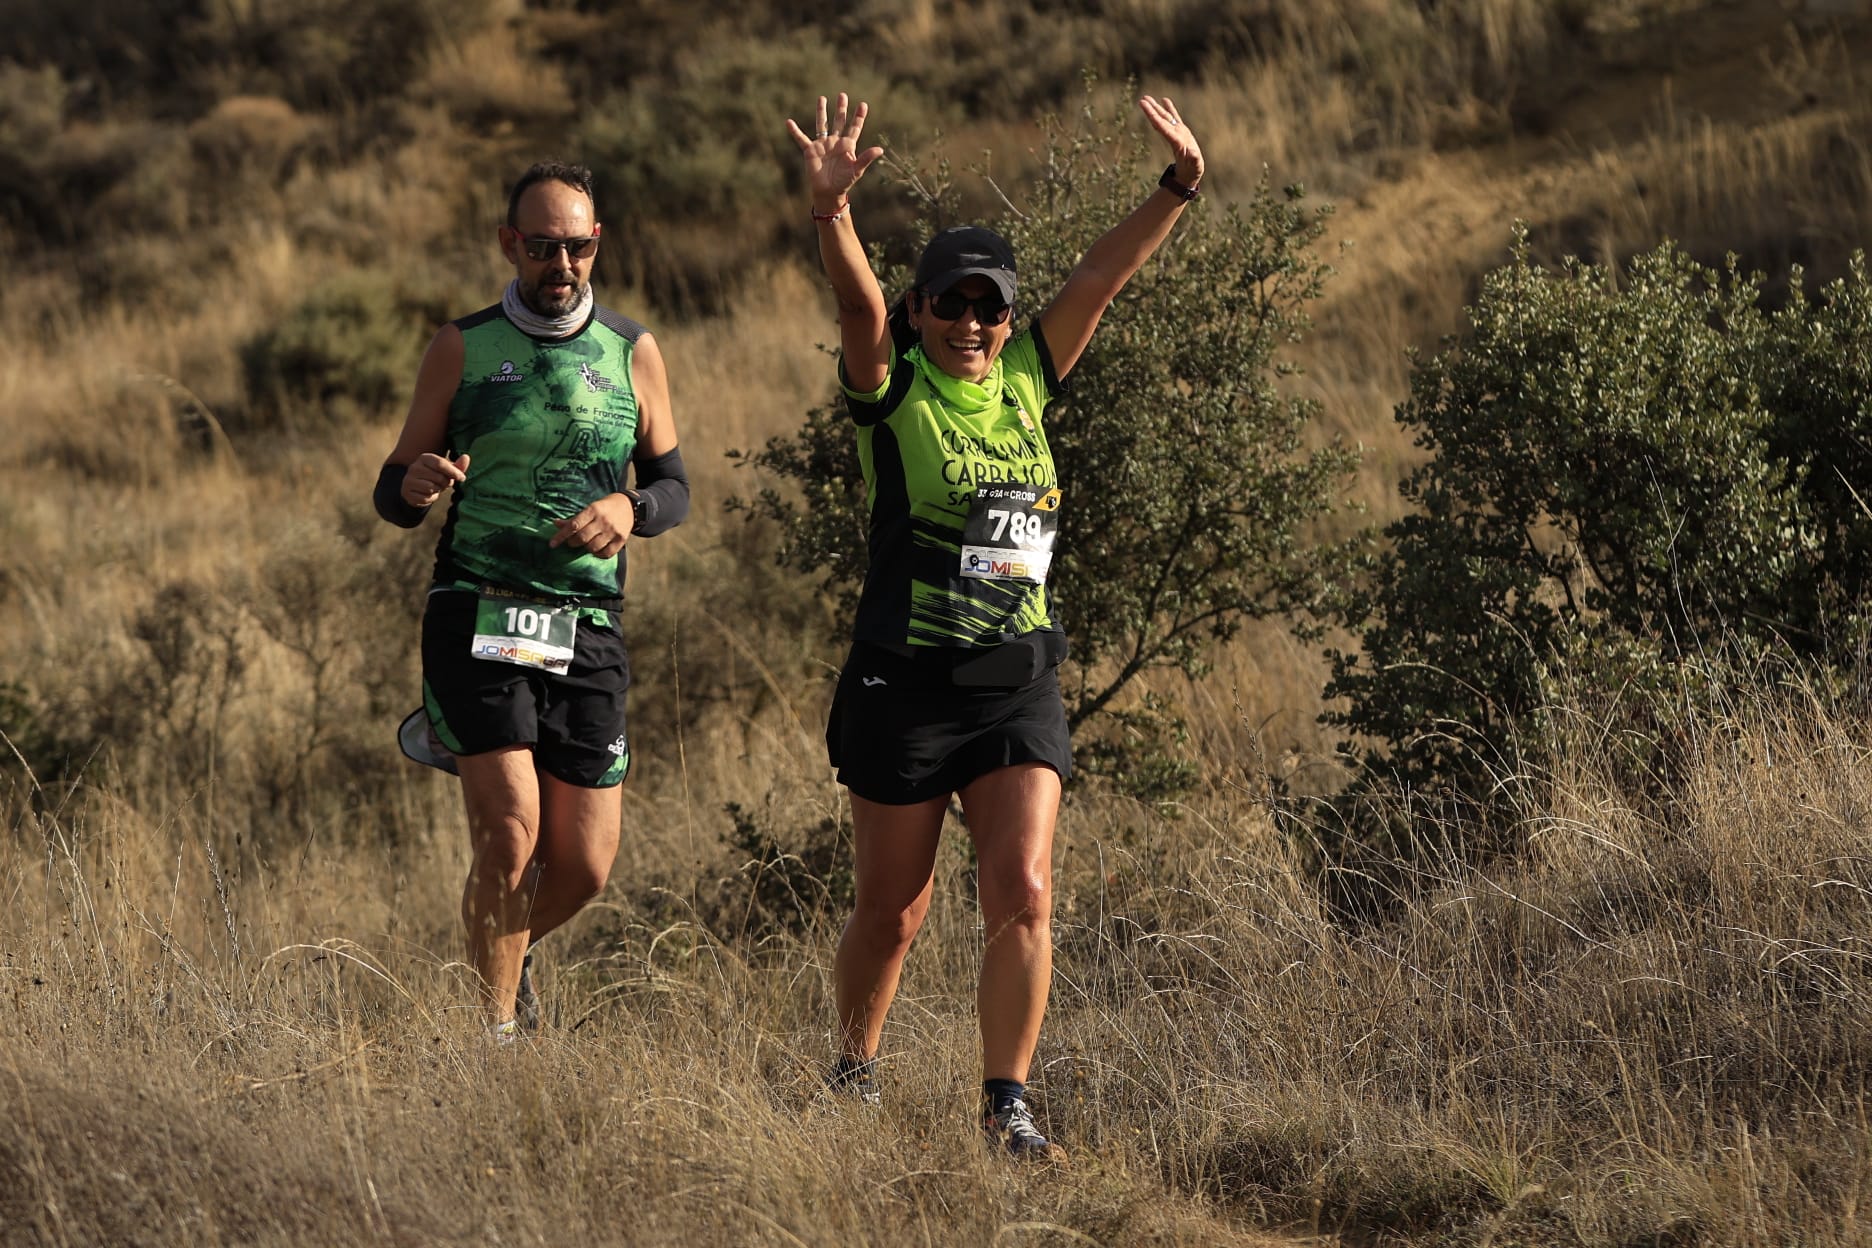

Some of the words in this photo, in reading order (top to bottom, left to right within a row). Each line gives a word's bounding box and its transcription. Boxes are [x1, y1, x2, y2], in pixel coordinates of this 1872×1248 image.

[490, 374, 523, 382] VIATOR
[576, 404, 589, 414] de
[1010, 490, 1036, 502] CROSS
[987, 509, 1042, 545] 789
[505, 607, 552, 641] 101
[476, 645, 568, 669] JOMISAGA
